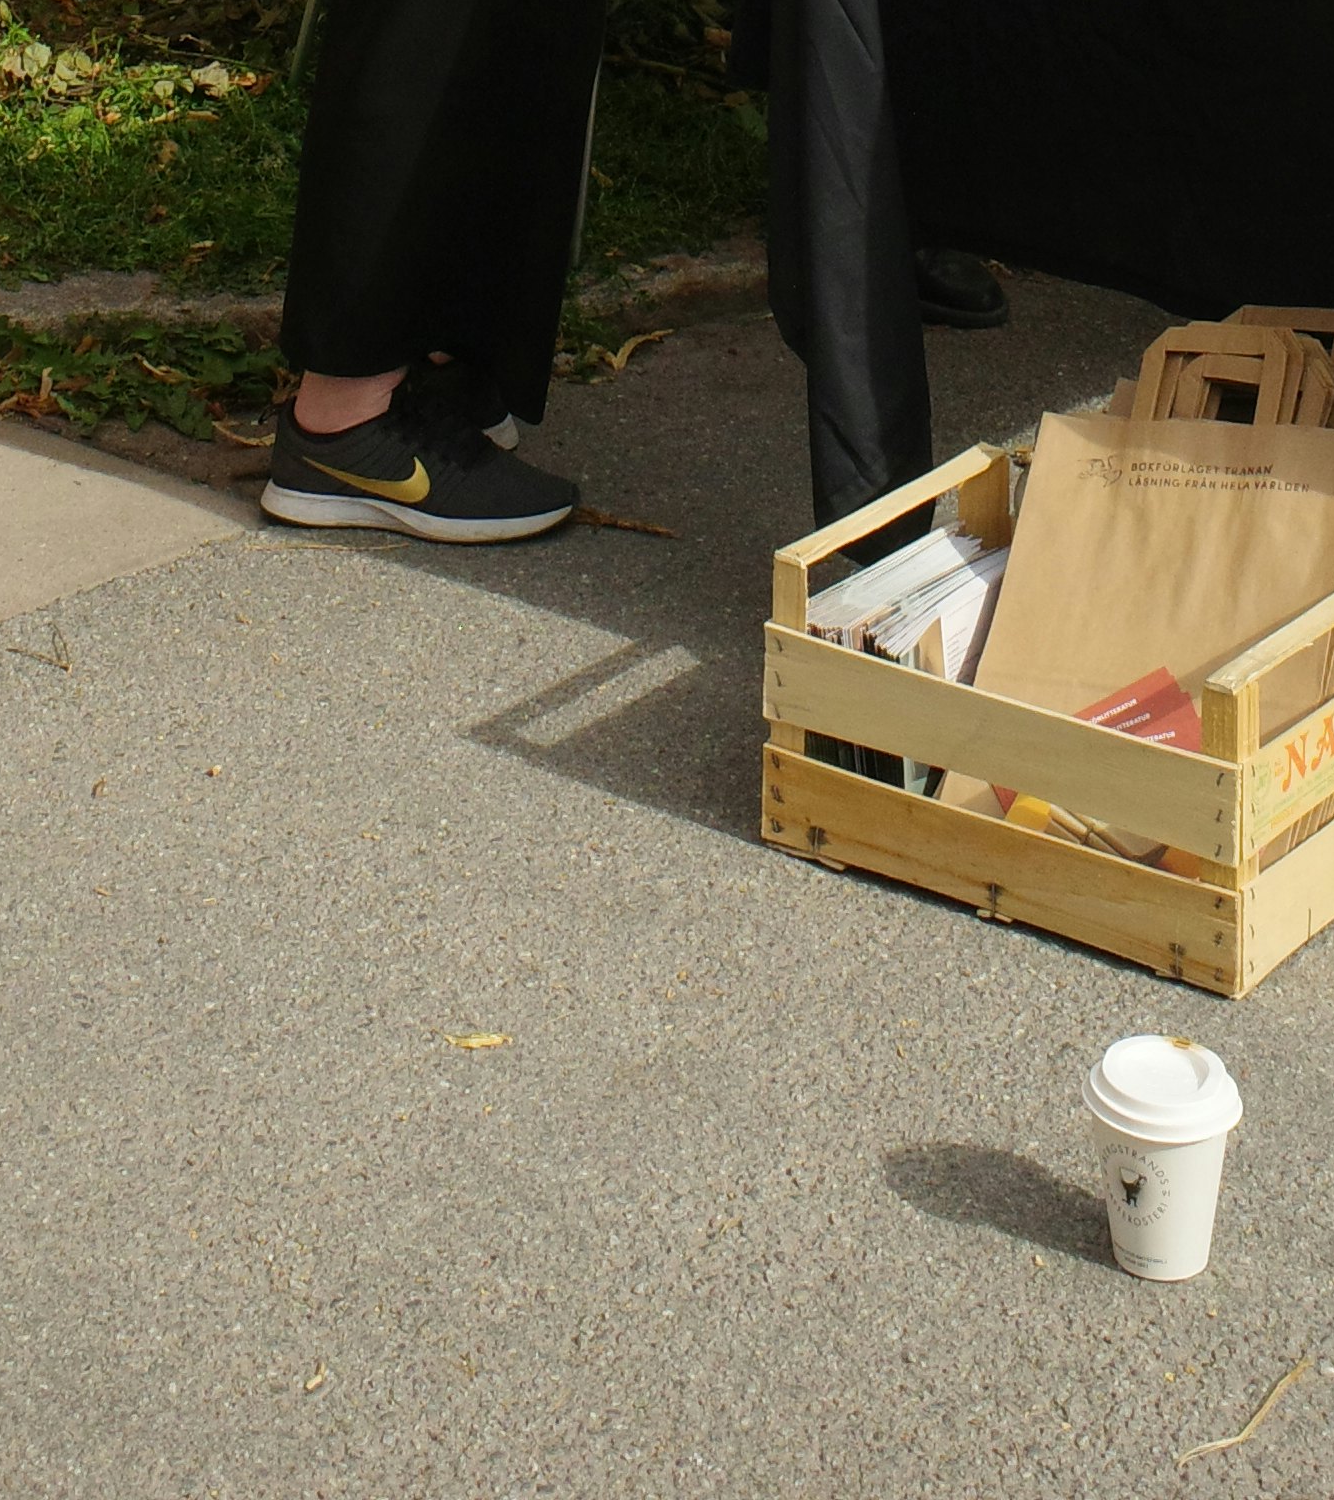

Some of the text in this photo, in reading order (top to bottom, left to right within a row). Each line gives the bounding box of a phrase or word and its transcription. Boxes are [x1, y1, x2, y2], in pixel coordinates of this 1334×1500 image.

[1131, 460, 1275, 476] BOKFÖRLAGET TRANAN
[1128, 475, 1180, 488] LÄSNING
[1184, 476, 1216, 490] FRÅN
[1220, 480, 1250, 491] HELA
